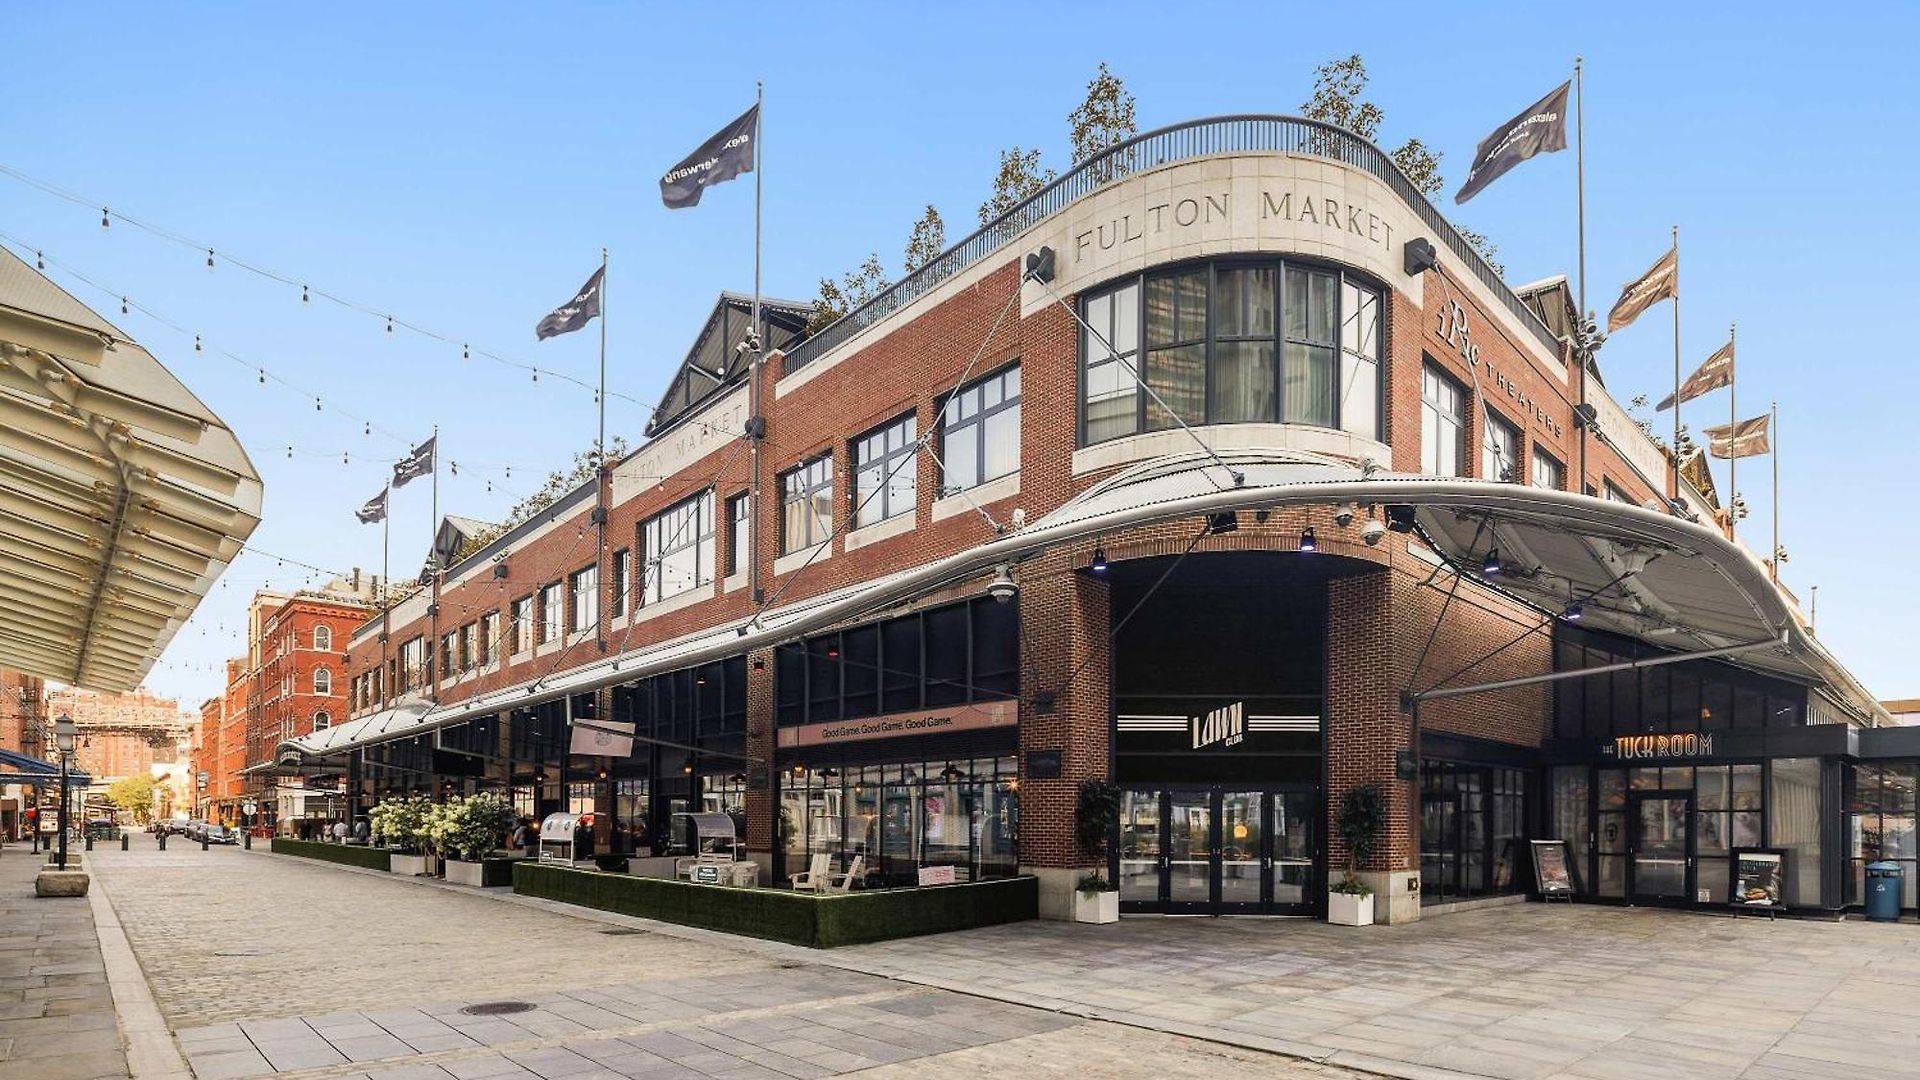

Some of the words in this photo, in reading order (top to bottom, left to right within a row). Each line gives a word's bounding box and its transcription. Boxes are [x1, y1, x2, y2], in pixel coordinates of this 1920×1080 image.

[1075, 193, 1229, 263] FULTON
[1262, 192, 1394, 251] MARKET
[1486, 361, 1562, 439] THEATERS
[822, 727, 839, 738] Good
[840, 727, 860, 737] Game.
[861, 723, 880, 734] Good
[882, 721, 904, 731] Game.
[906, 717, 926, 729] Good
[927, 716, 953, 728] Game.
[1193, 701, 1242, 749] LAWN
[1225, 733, 1243, 747] CLUB
[1615, 736, 1653, 759] TUCK
[1656, 733, 1712, 757] ROOM
